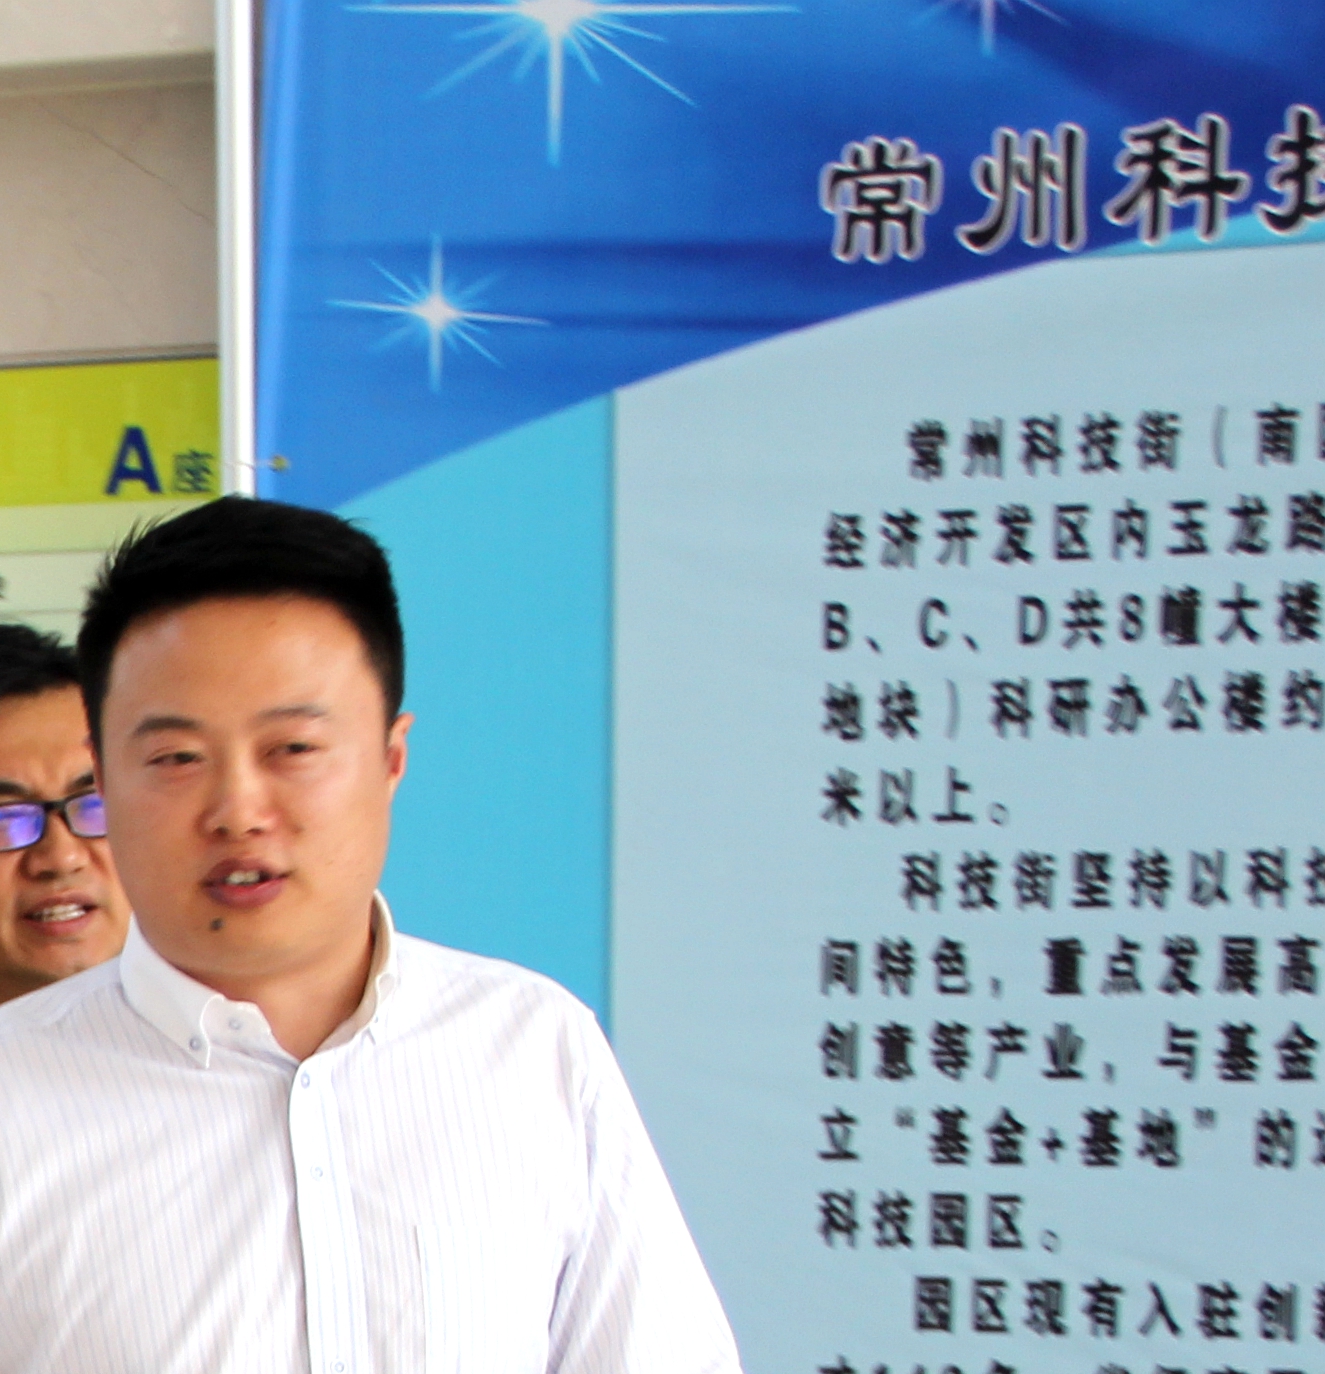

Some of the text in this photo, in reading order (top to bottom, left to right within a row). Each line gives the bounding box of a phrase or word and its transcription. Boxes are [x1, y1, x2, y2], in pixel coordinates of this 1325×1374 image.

[906, 402, 1325, 482] 常州科技街（南
[823, 491, 1325, 570] 经济开发区内玉龙路
[821, 766, 1007, 827] 米以上。
[820, 934, 1322, 997] 间特色，重点发展高
[818, 1020, 1320, 1083] 创意等产业，与基金
[817, 1189, 1058, 1252] 科技园区。
